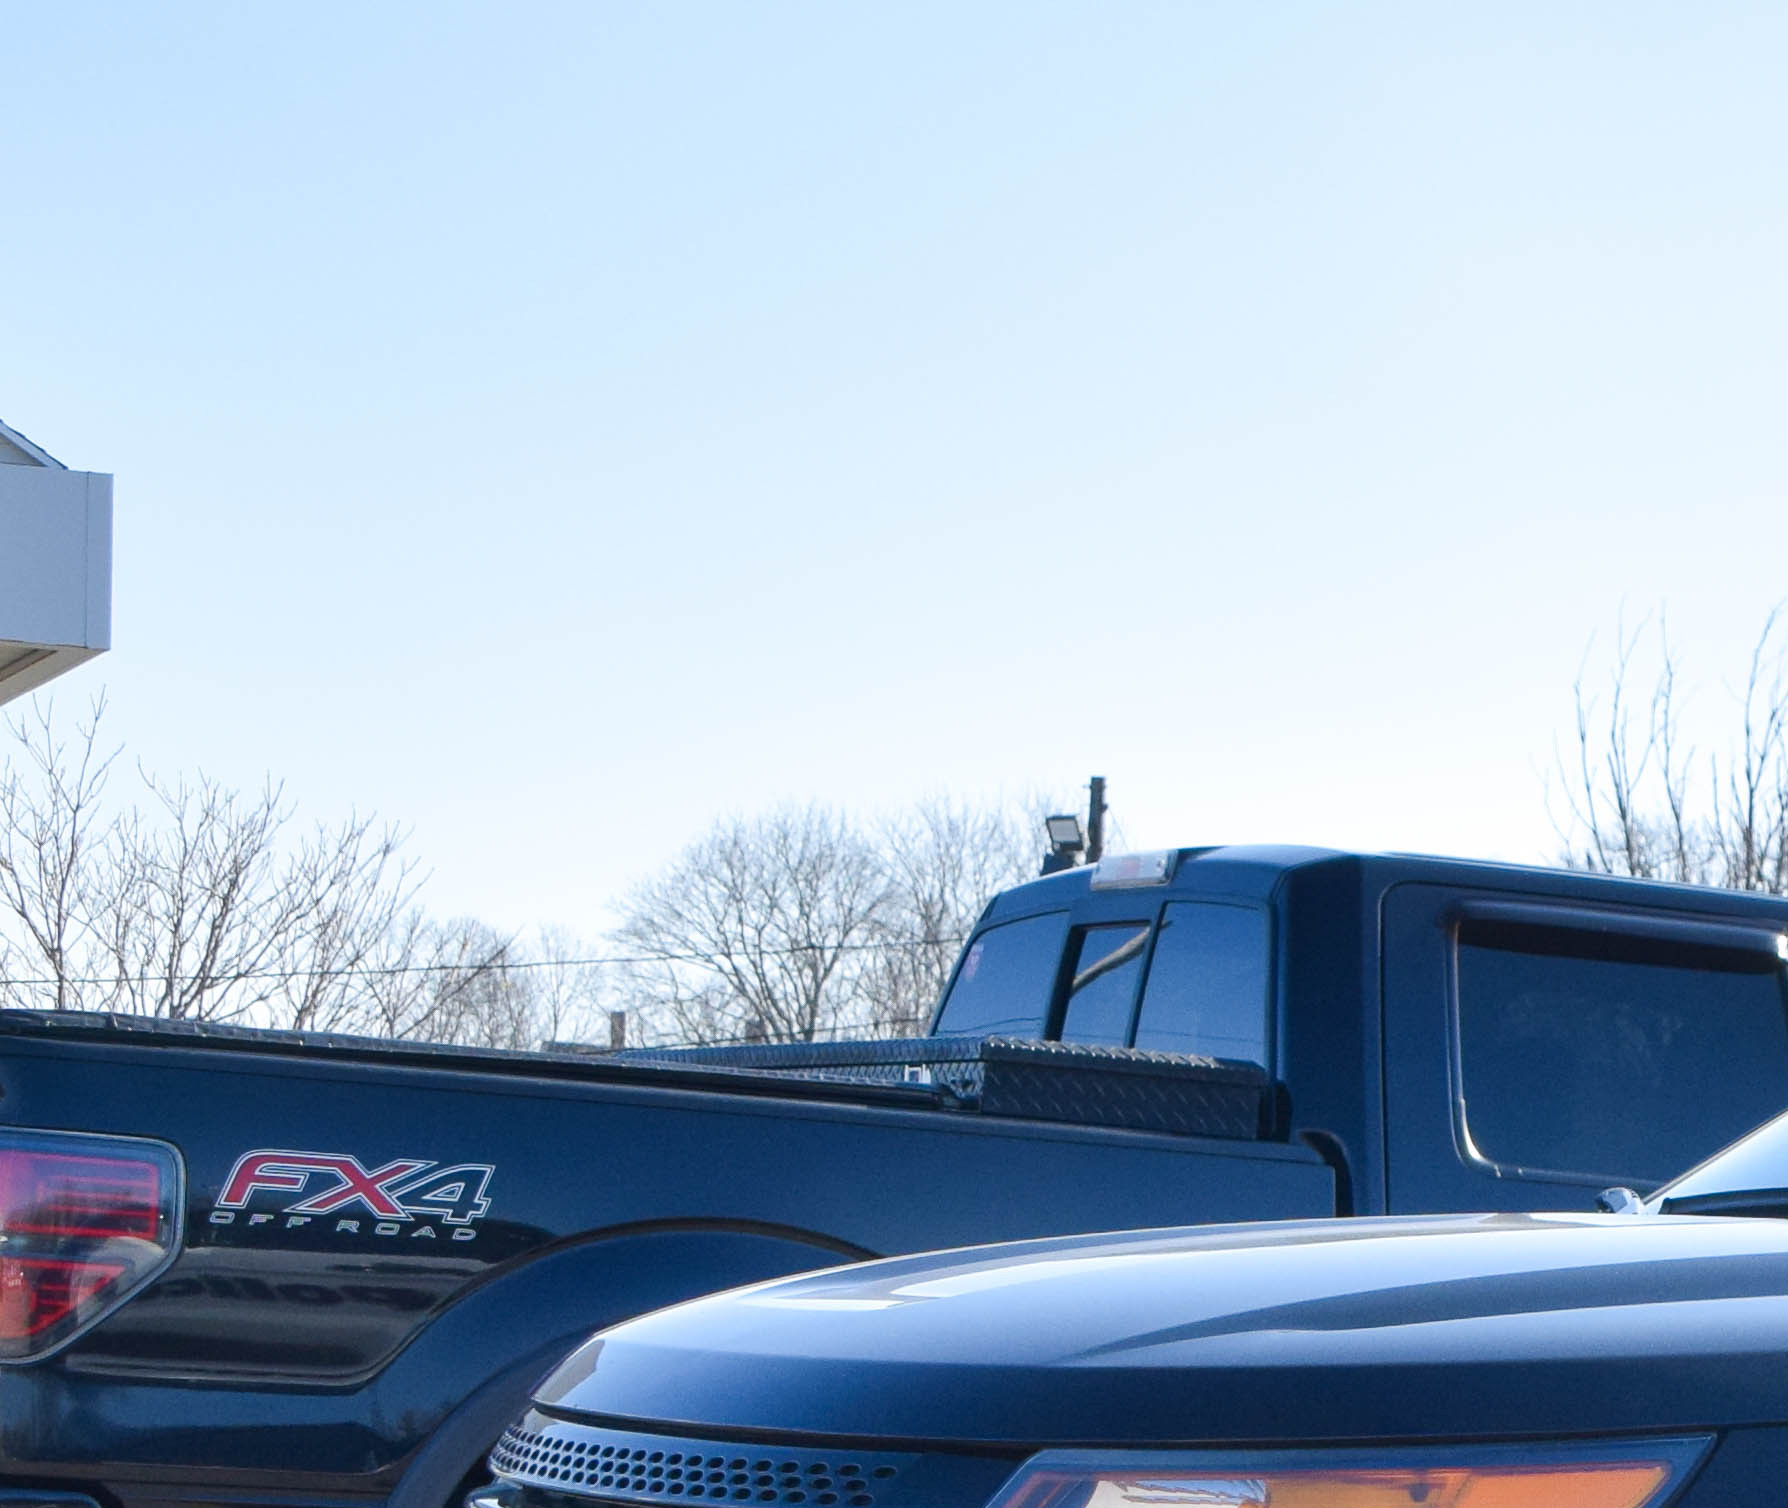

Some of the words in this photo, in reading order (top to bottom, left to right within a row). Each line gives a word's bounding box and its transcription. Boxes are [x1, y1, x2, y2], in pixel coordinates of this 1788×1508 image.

[215, 1149, 496, 1225] FX4
[209, 1210, 312, 1229] OFF
[335, 1218, 477, 1242] ROAD
